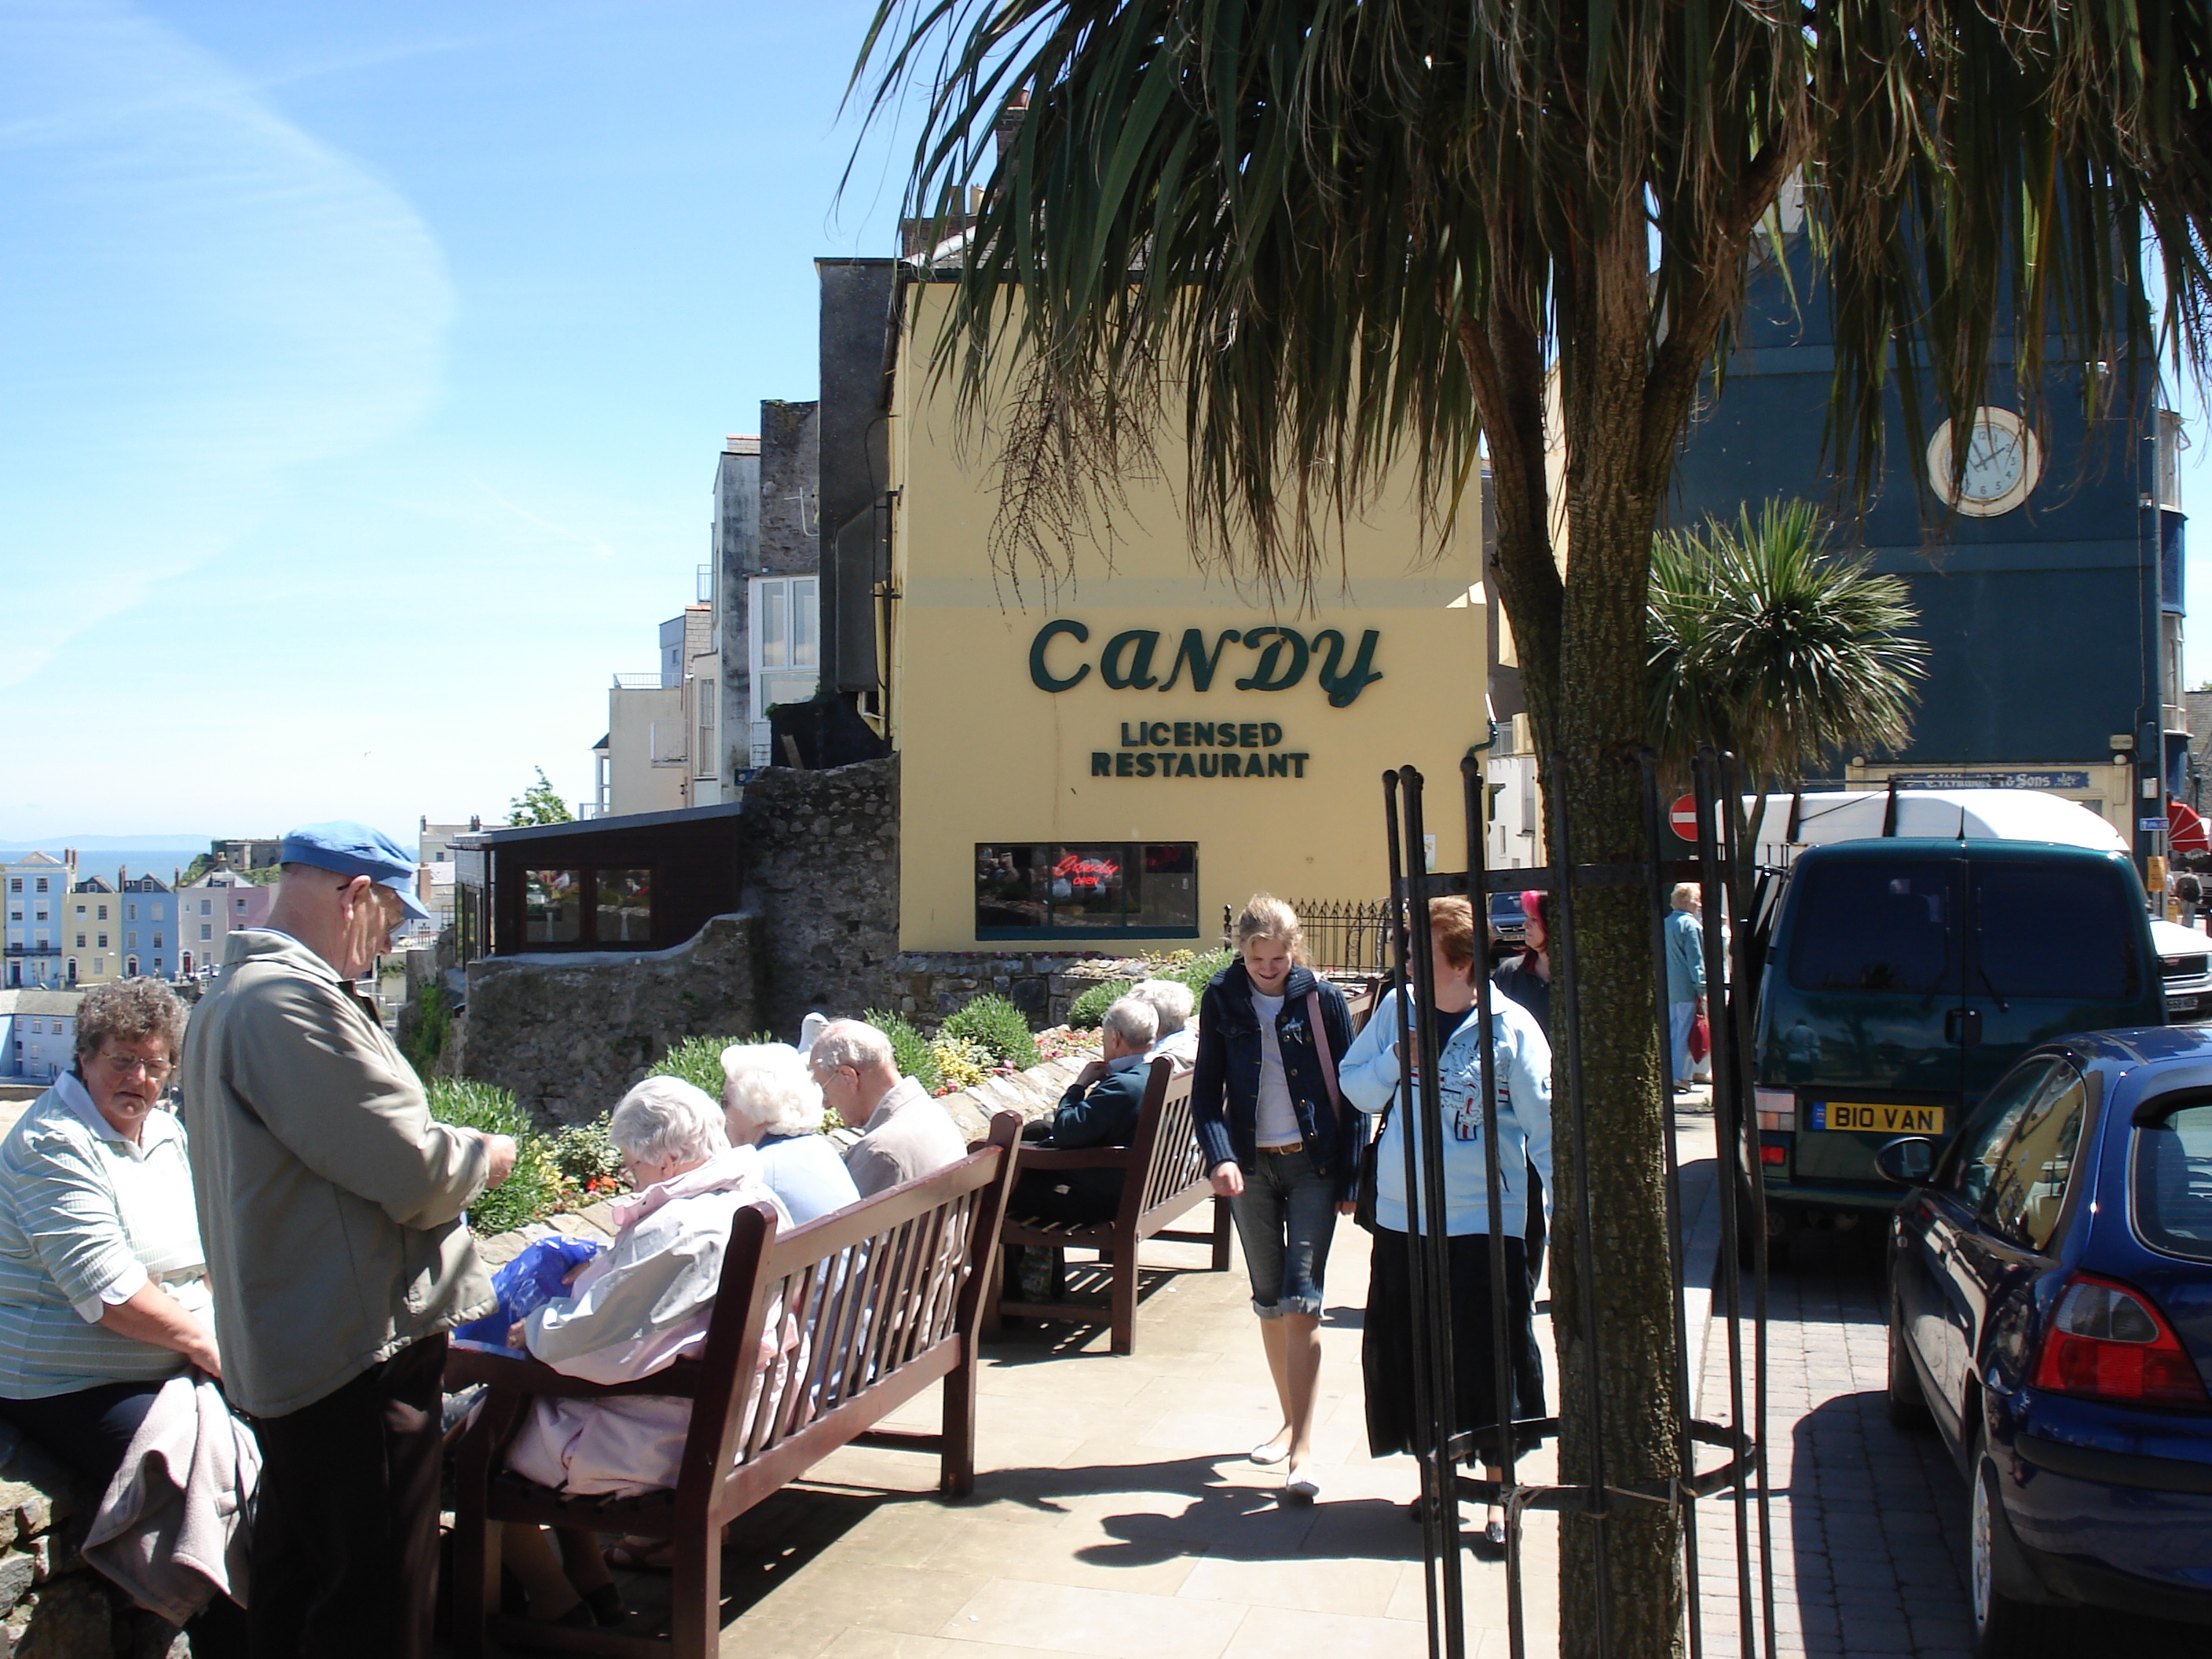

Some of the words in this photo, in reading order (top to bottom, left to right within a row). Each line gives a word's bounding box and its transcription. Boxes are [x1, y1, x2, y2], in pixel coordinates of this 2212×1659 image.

[1029, 619, 1383, 708] CANDY
[1121, 722, 1282, 747] LICENSED
[1091, 752, 1309, 778] RESTAURANT
[2016, 773, 2050, 788] Sons
[1072, 877, 1100, 885] OPEN
[1884, 1108, 1933, 1130] VAN
